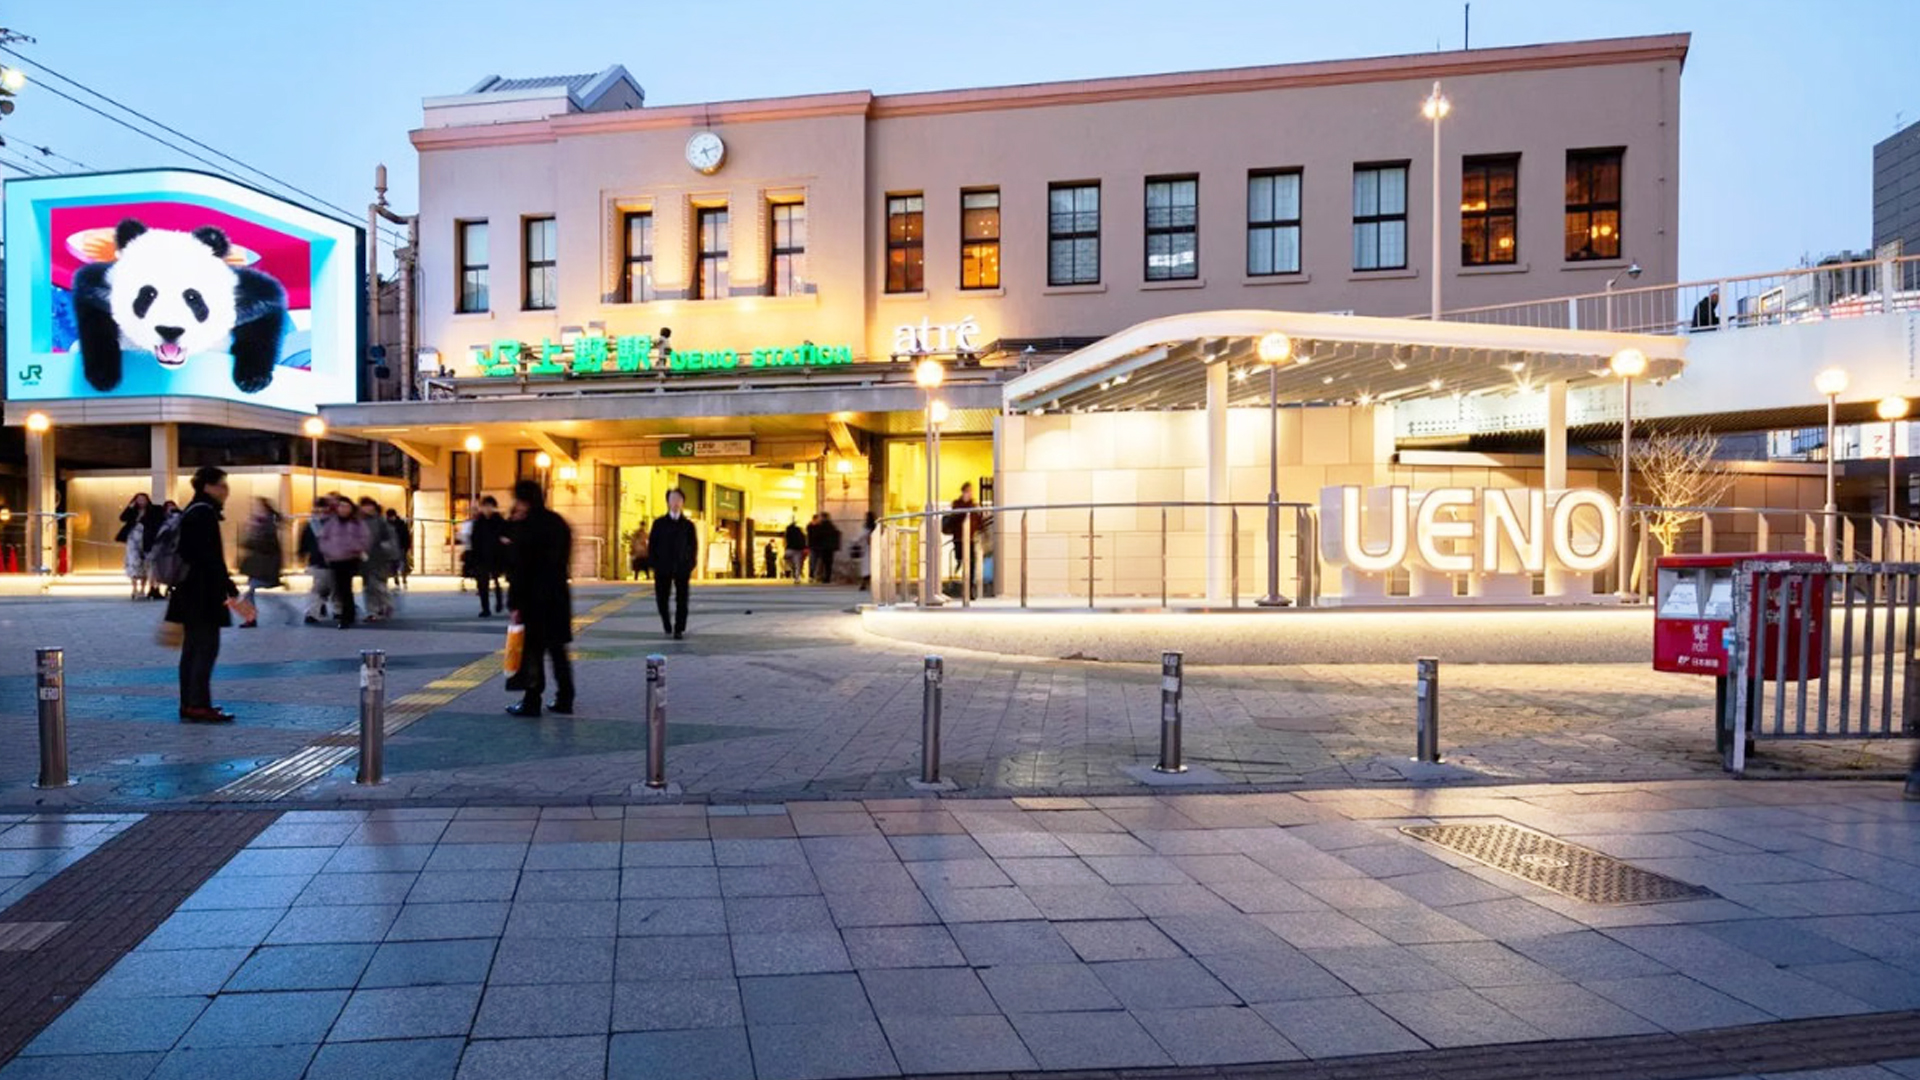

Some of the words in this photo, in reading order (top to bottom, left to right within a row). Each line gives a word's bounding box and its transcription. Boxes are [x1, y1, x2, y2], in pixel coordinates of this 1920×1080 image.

[893, 314, 981, 353] atré
[19, 364, 42, 380] JR
[477, 338, 520, 365] JR
[529, 336, 652, 374] 上野駅
[670, 349, 738, 370] UENO
[751, 343, 852, 367] STATION
[1342, 485, 1618, 571] UENO
